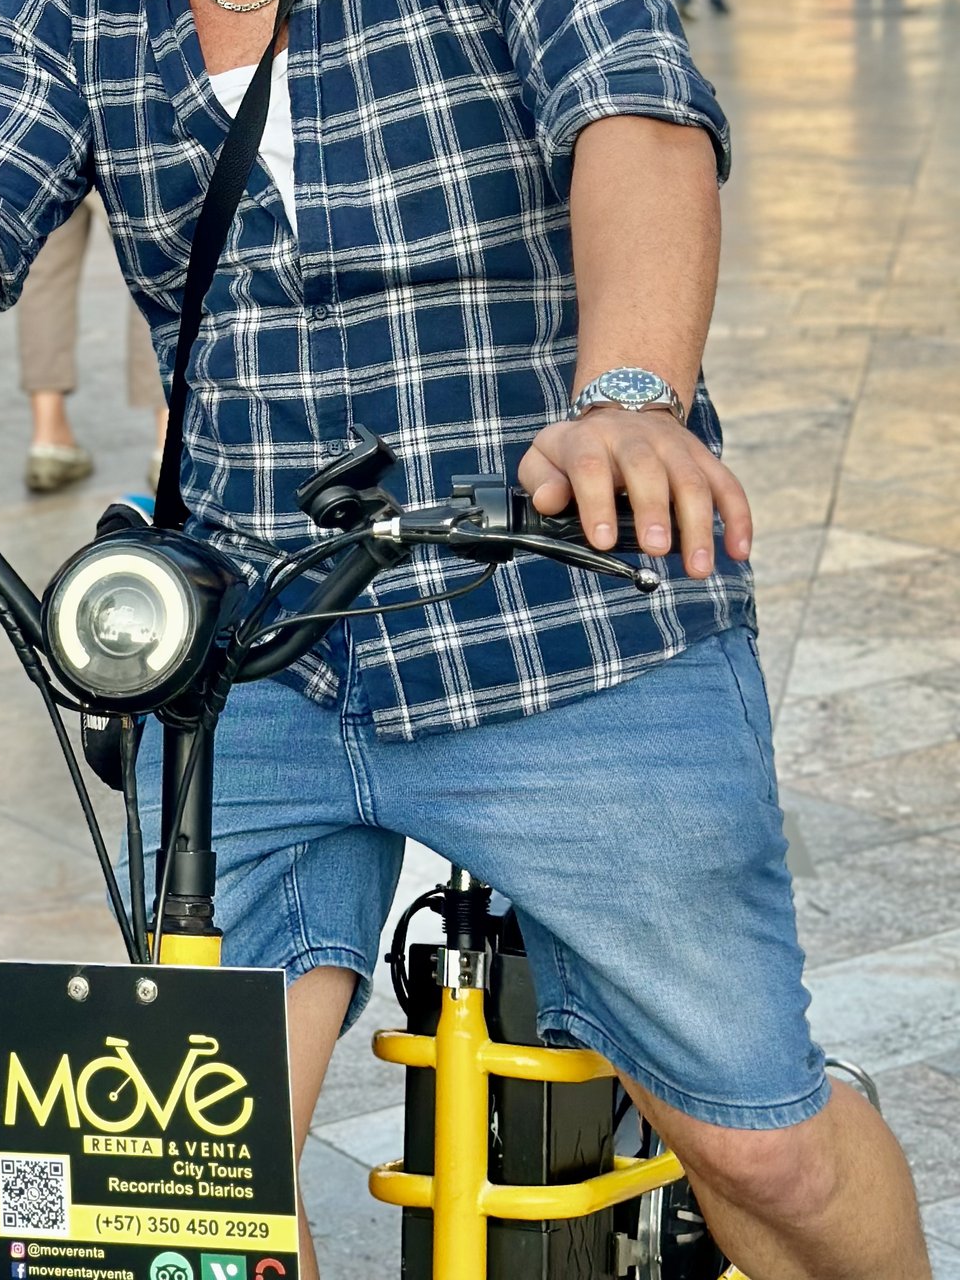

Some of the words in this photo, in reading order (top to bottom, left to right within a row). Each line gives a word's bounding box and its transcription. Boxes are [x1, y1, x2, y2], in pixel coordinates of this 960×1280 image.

[91, 1138, 154, 1154] RENTA
[168, 1142, 179, 1156] &
[185, 1141, 251, 1159] VENTA
[173, 1161, 203, 1180] City
[208, 1163, 253, 1179] Tours
[108, 1177, 194, 1195] Recorridos
[199, 1182, 254, 1198] Diarios
[95, 1214, 142, 1235] (+57)
[148, 1216, 180, 1233] 350
[186, 1219, 219, 1236] 450
[225, 1221, 270, 1239] 2929
[27, 1243, 105, 1258] @moverenta
[28, 1265, 134, 1280] moverentayventa
